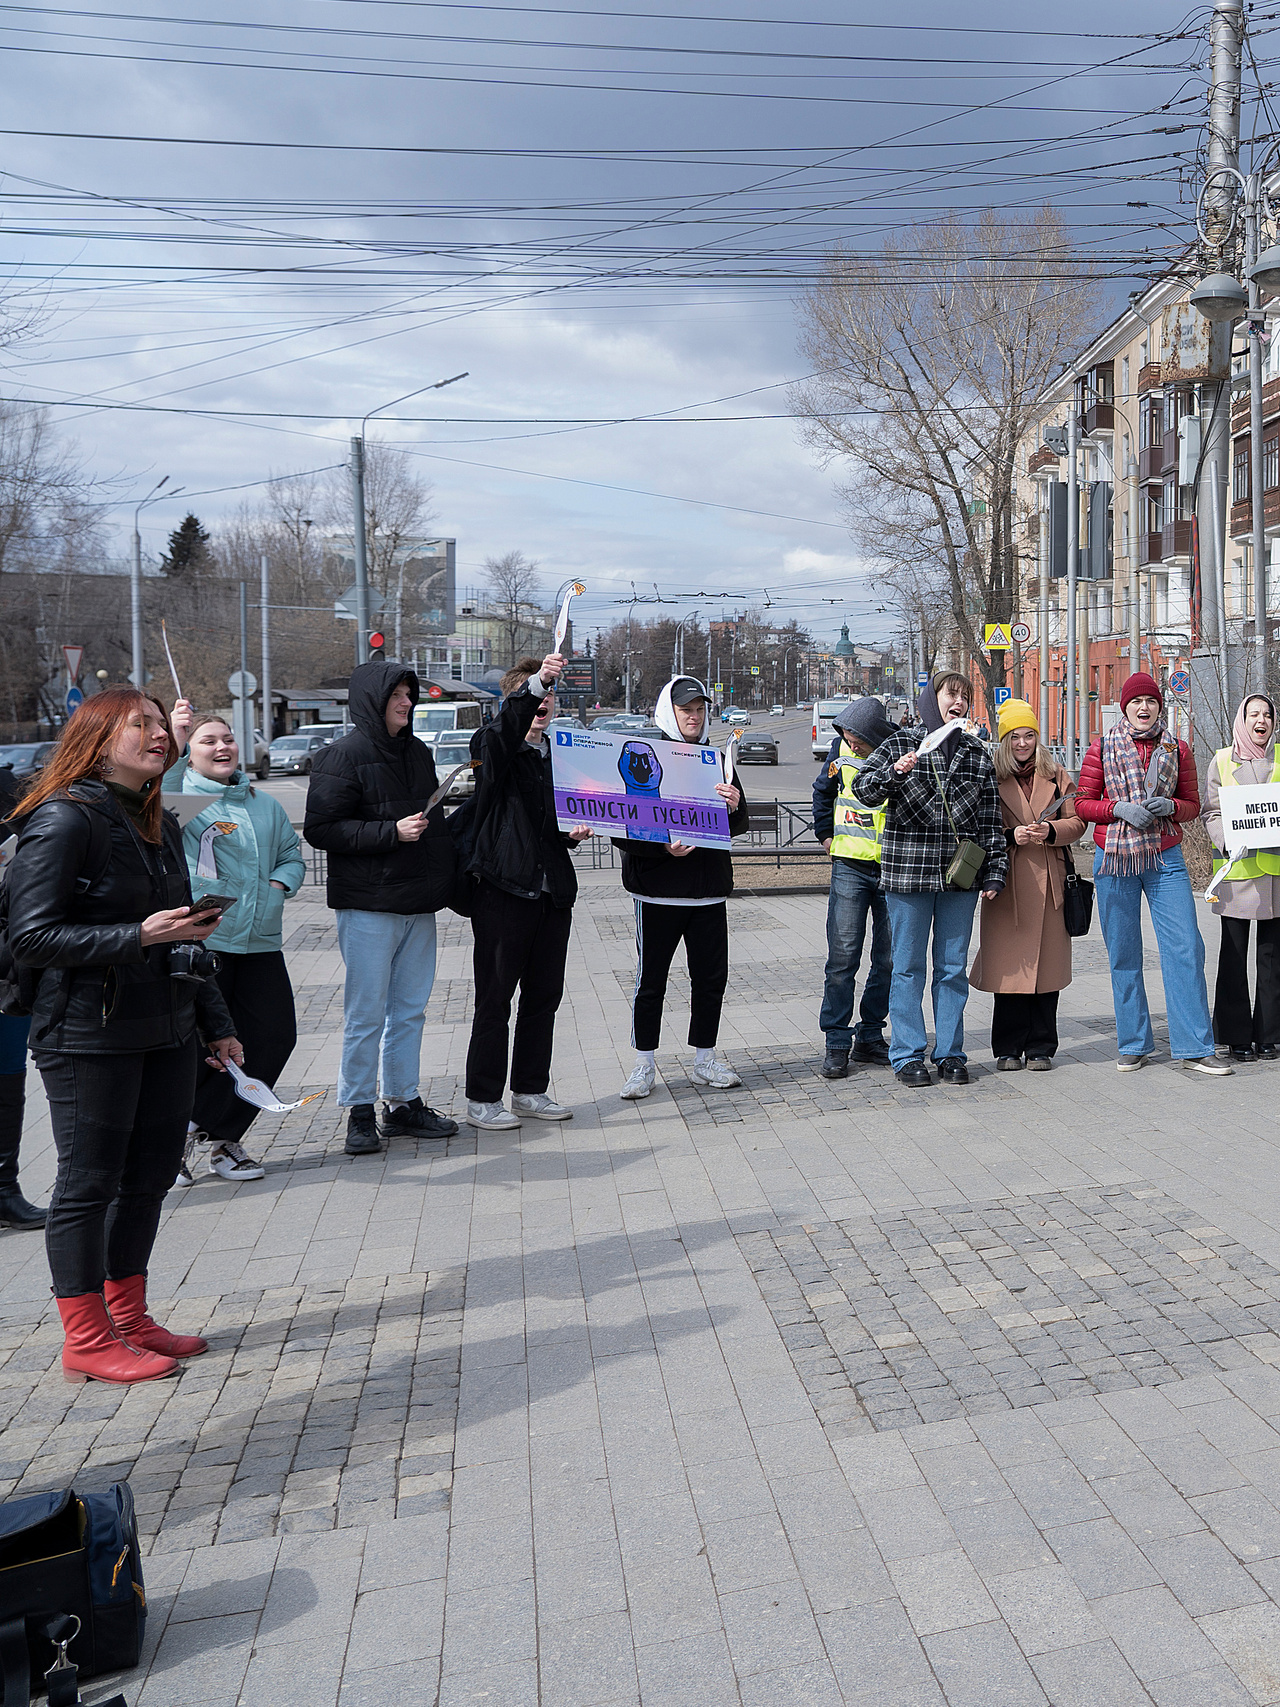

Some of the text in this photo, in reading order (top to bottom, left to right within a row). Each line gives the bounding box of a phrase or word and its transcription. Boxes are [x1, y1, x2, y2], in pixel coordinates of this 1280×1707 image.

[1015, 628, 1026, 636] 40
[566, 796, 719, 830] ОТПУСТИ ГУСЕЙ!!!
[1245, 801, 1279, 815] МЕСТО
[1231, 816, 1267, 831] ВАШЕЙ
